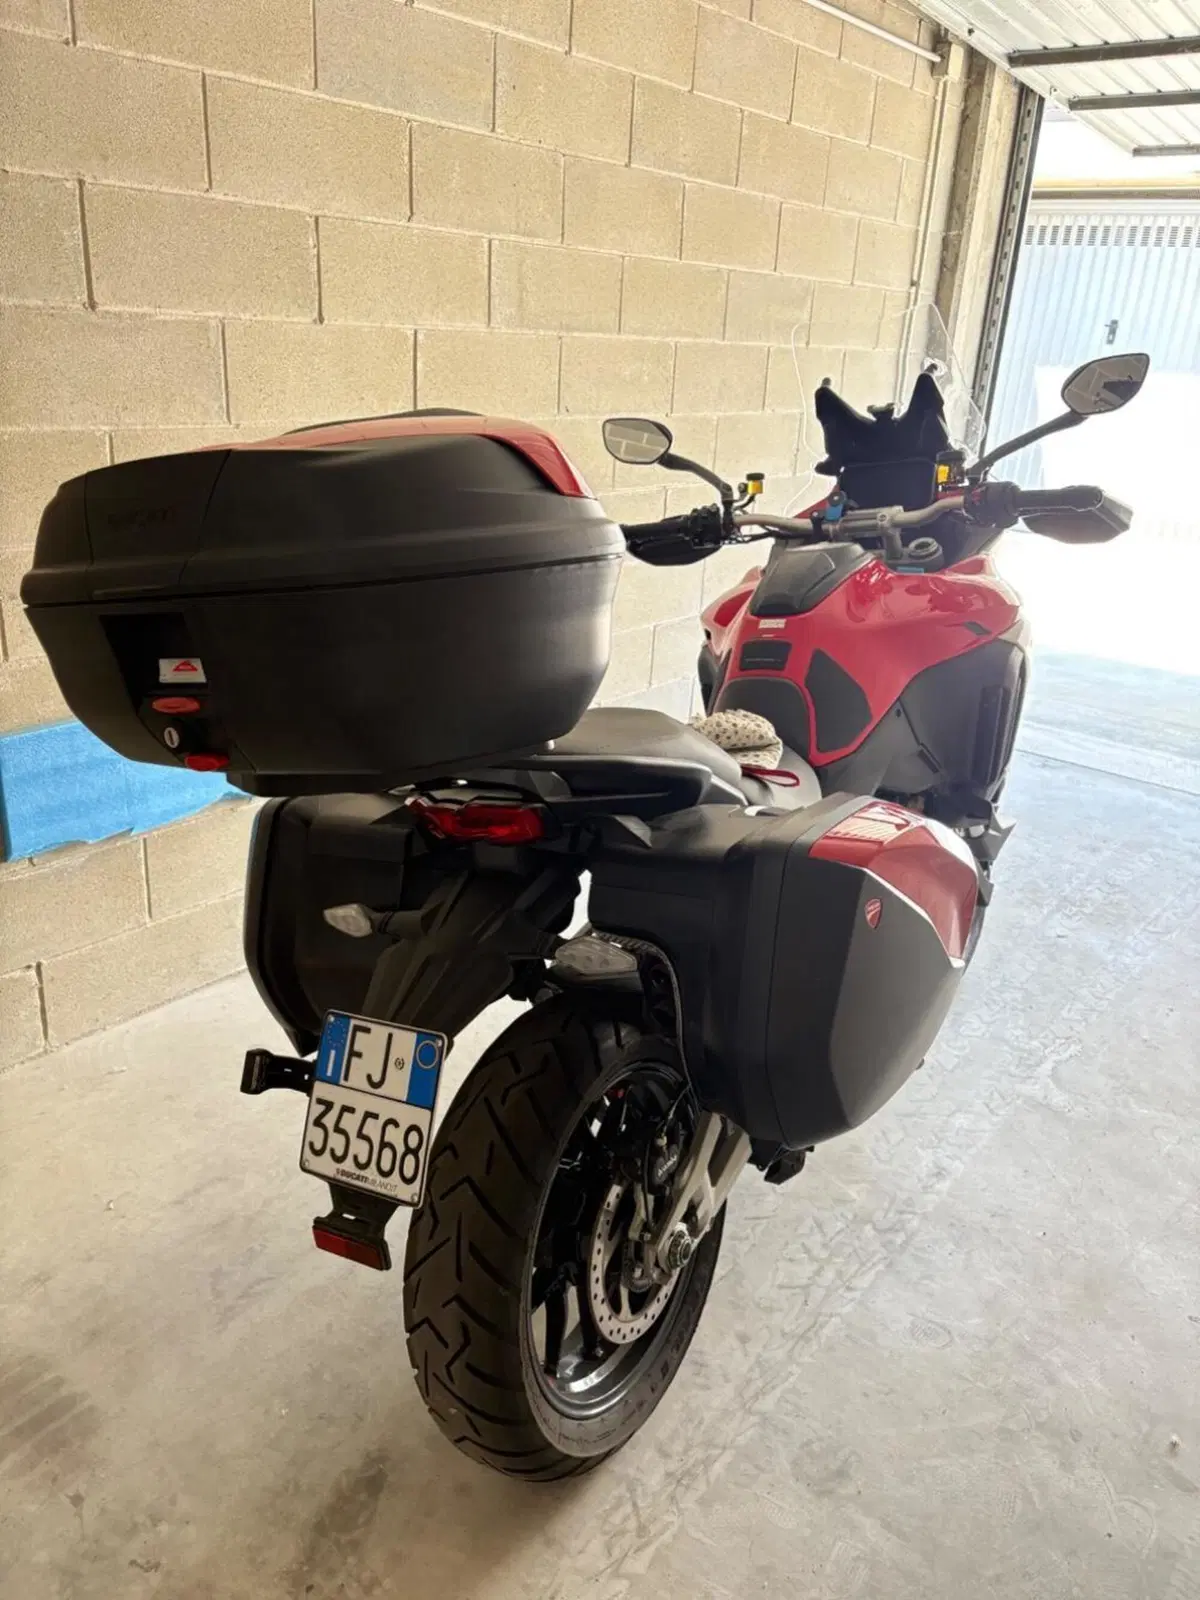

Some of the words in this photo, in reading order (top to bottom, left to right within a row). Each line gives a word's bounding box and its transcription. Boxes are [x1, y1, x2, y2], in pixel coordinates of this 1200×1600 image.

[326, 1049, 336, 1077] I
[343, 1023, 393, 1090] FJ
[308, 1098, 424, 1186] 35568
